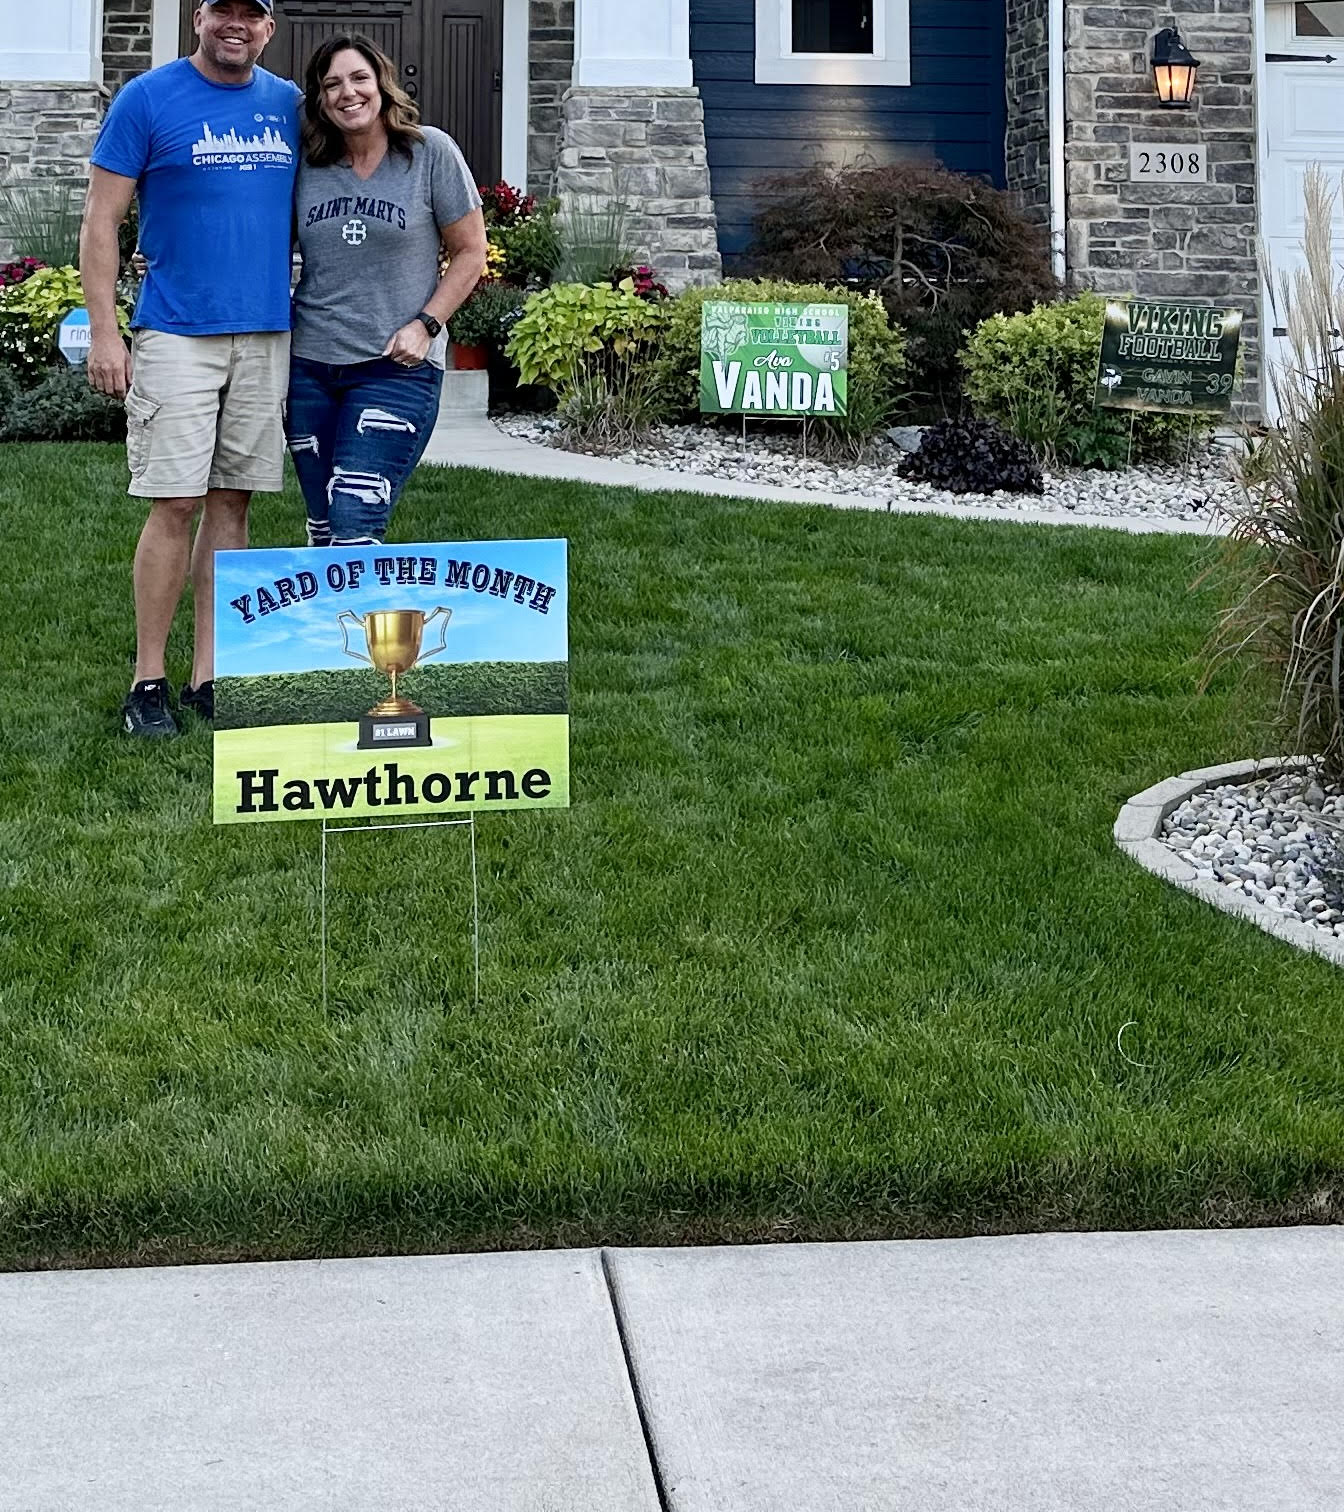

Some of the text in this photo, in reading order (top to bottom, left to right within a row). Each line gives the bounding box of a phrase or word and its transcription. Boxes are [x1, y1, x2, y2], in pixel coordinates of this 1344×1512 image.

[193, 153, 292, 165] CHICAGO ASSEMBLY
[1138, 152, 1200, 174] 2308
[306, 196, 406, 230] SAINT MARY'S
[775, 308, 798, 316] HIGH
[803, 308, 840, 317] SCHOOL
[1127, 303, 1225, 339] VIKING
[750, 328, 843, 345] VOLLEYBALL
[1118, 333, 1223, 361] FOOTBALL
[753, 349, 793, 370] Ava
[711, 360, 835, 412] VANDA
[1141, 368, 1193, 385] GAVIN
[1206, 373, 1233, 394] 39
[1136, 387, 1193, 405] VANDA
[230, 557, 557, 624] YARD OF THE MONTH
[387, 727, 415, 736] LAWN
[236, 763, 552, 814] Hawthorne
